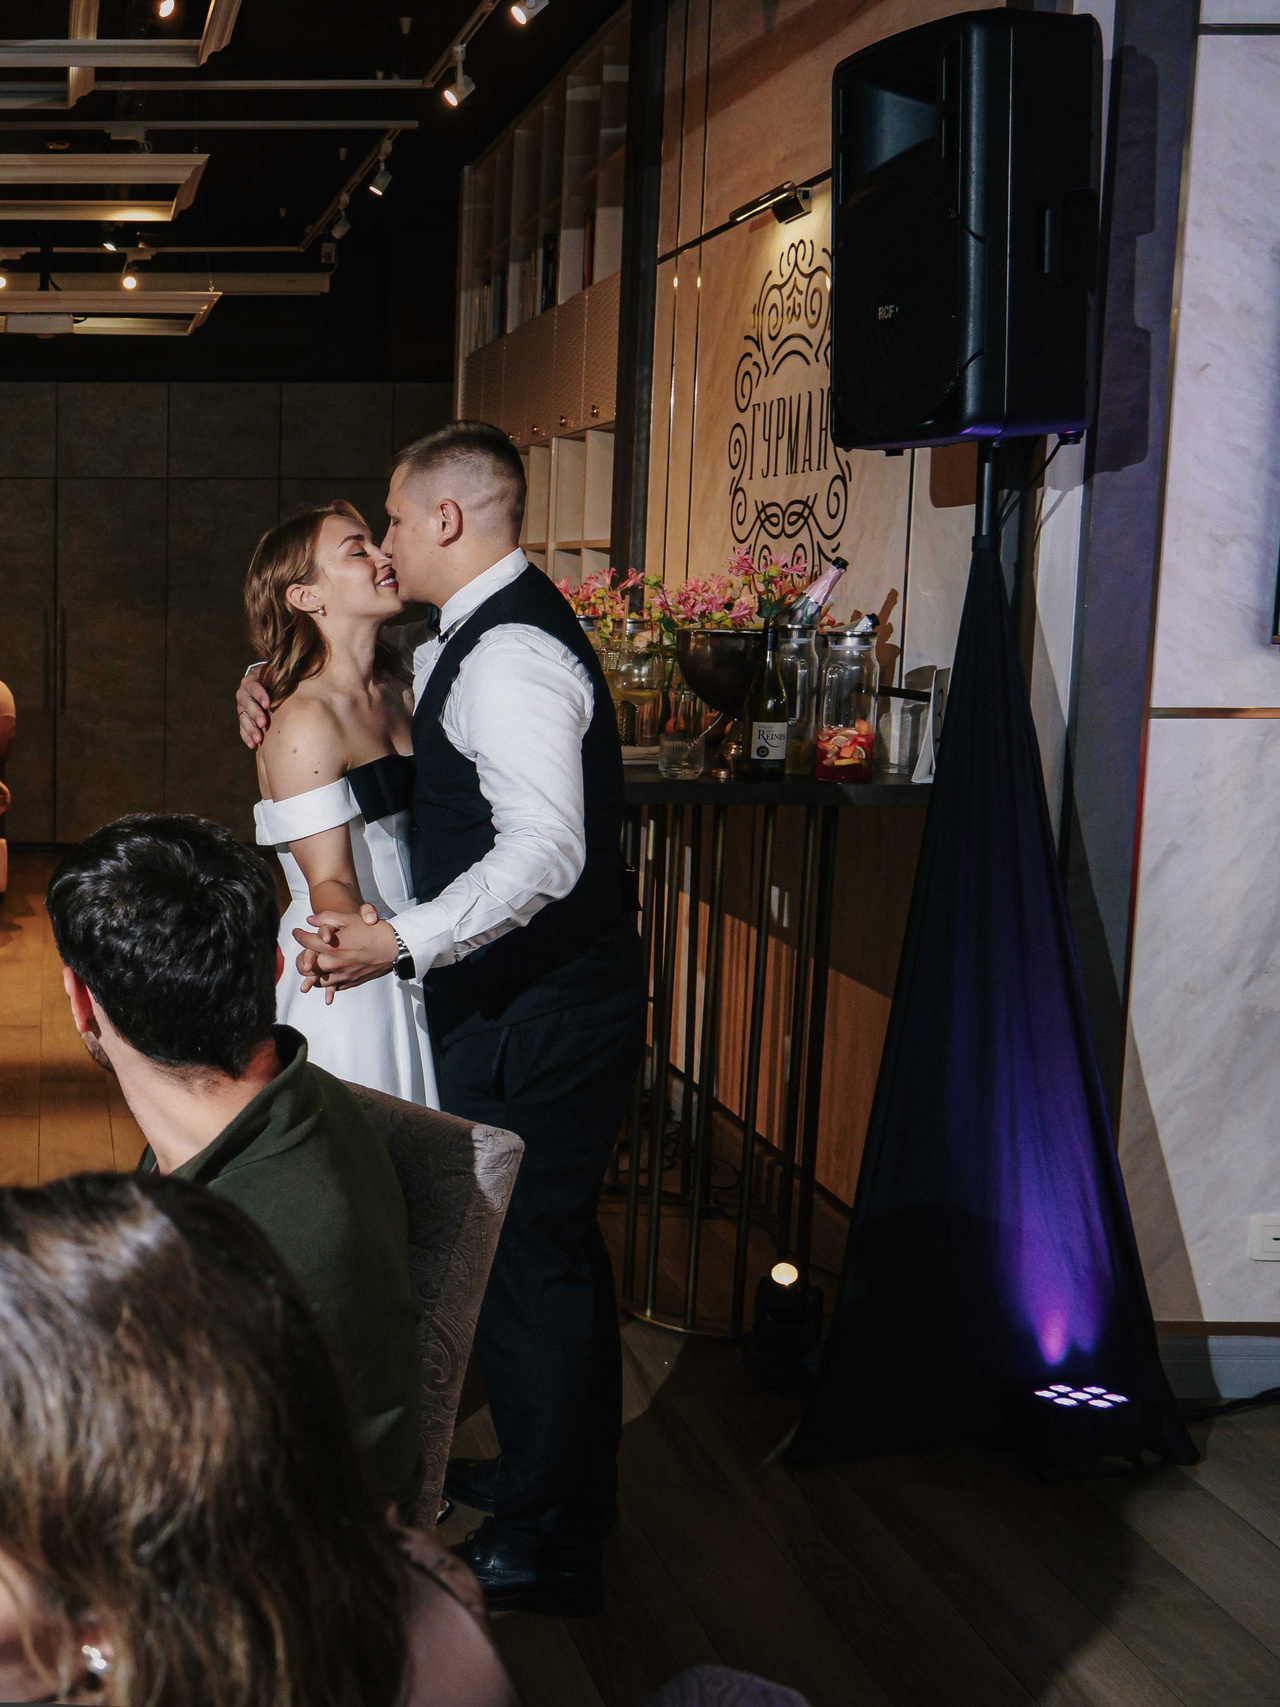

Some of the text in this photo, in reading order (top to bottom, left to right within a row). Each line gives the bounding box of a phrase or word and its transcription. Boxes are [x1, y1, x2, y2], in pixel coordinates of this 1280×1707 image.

[878, 304, 894, 320] RCF
[748, 385, 832, 480] ГУРМАН
[758, 729, 786, 745] REINES
